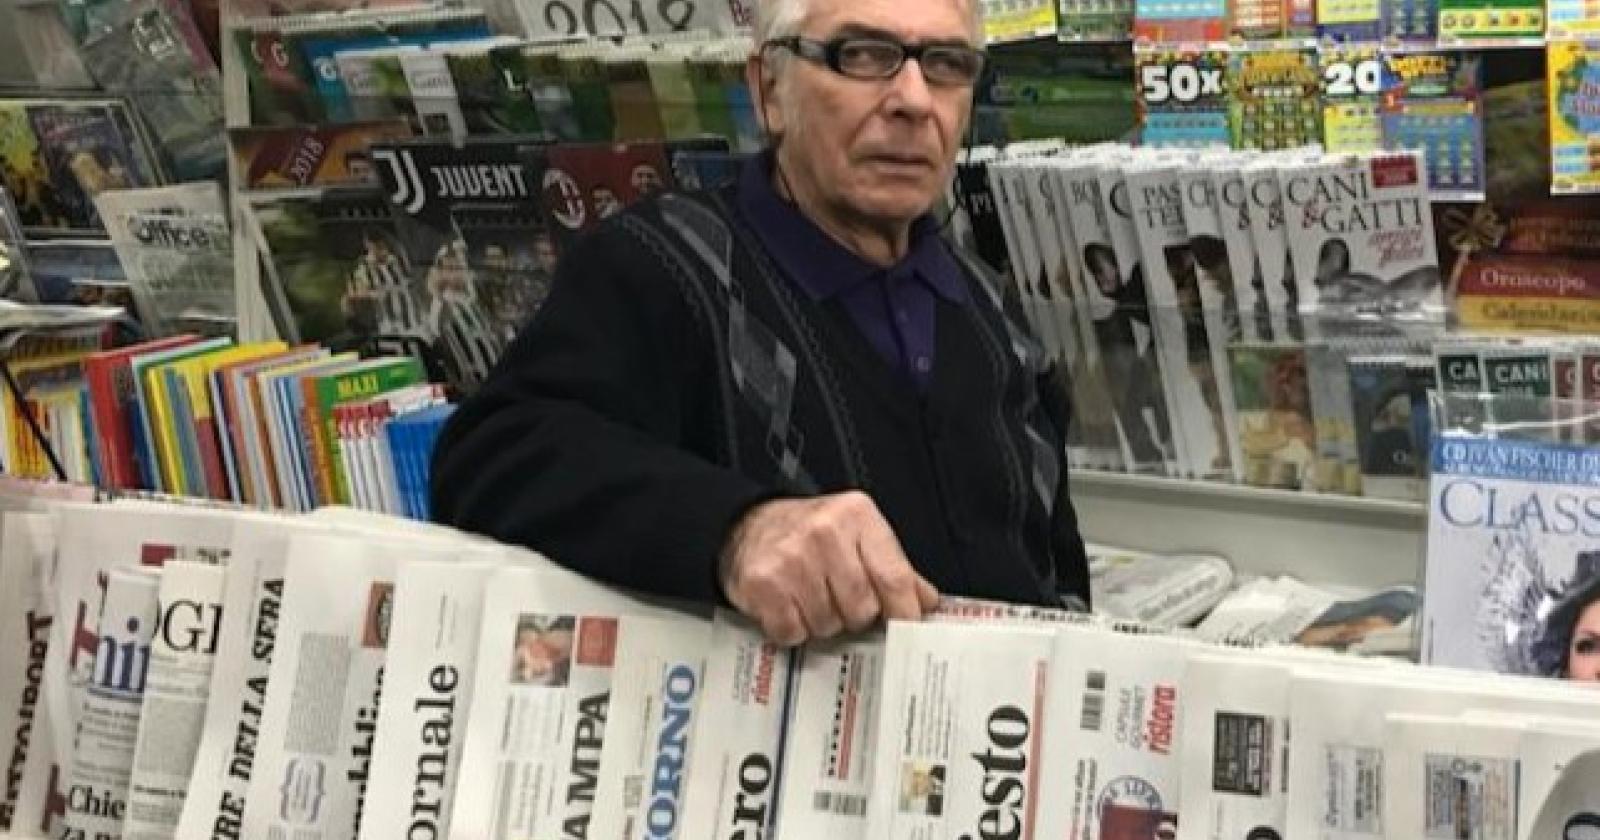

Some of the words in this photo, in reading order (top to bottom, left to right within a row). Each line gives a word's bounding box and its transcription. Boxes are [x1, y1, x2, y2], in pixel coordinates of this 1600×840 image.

[1286, 171, 1369, 207] CANI
[1319, 197, 1422, 233] GATTI
[227, 676, 270, 783] DELLA
[252, 577, 285, 665] SERA
[643, 663, 696, 840] ORNO
